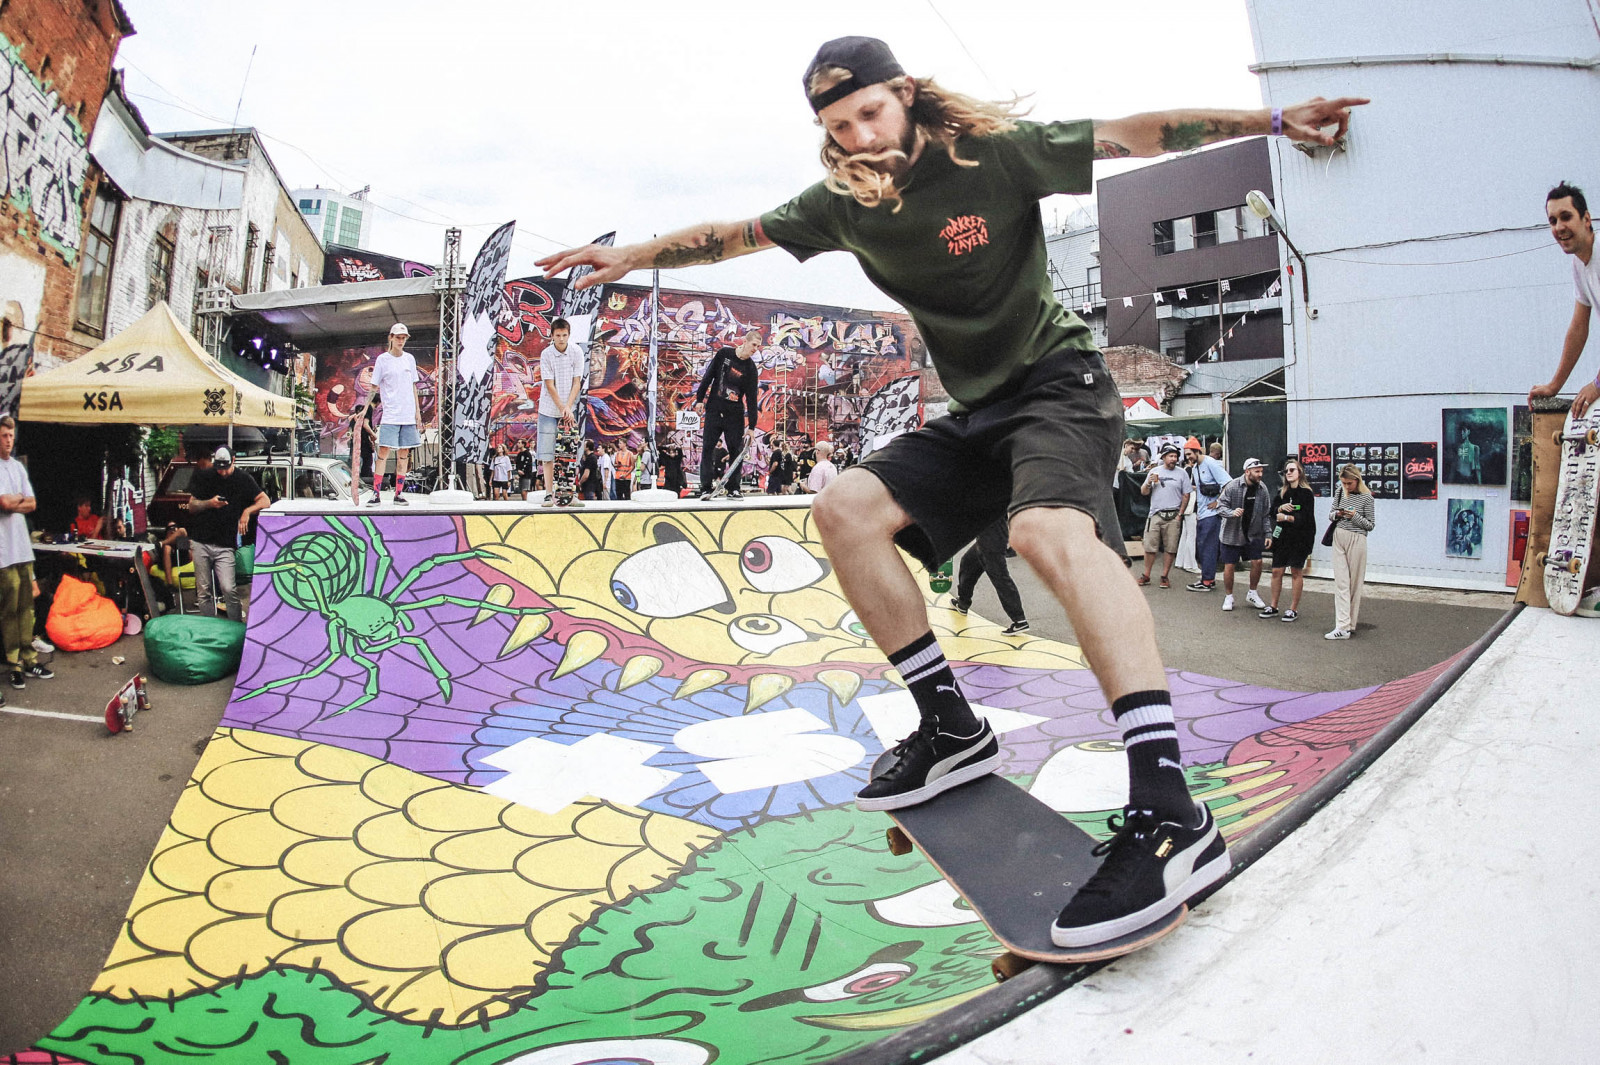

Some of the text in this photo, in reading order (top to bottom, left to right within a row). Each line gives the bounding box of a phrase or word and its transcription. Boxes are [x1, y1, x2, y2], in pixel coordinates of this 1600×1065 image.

[86, 352, 164, 375] XSA
[82, 391, 124, 412] XSA
[263, 399, 277, 417] XSA
[1305, 444, 1328, 457] 600
